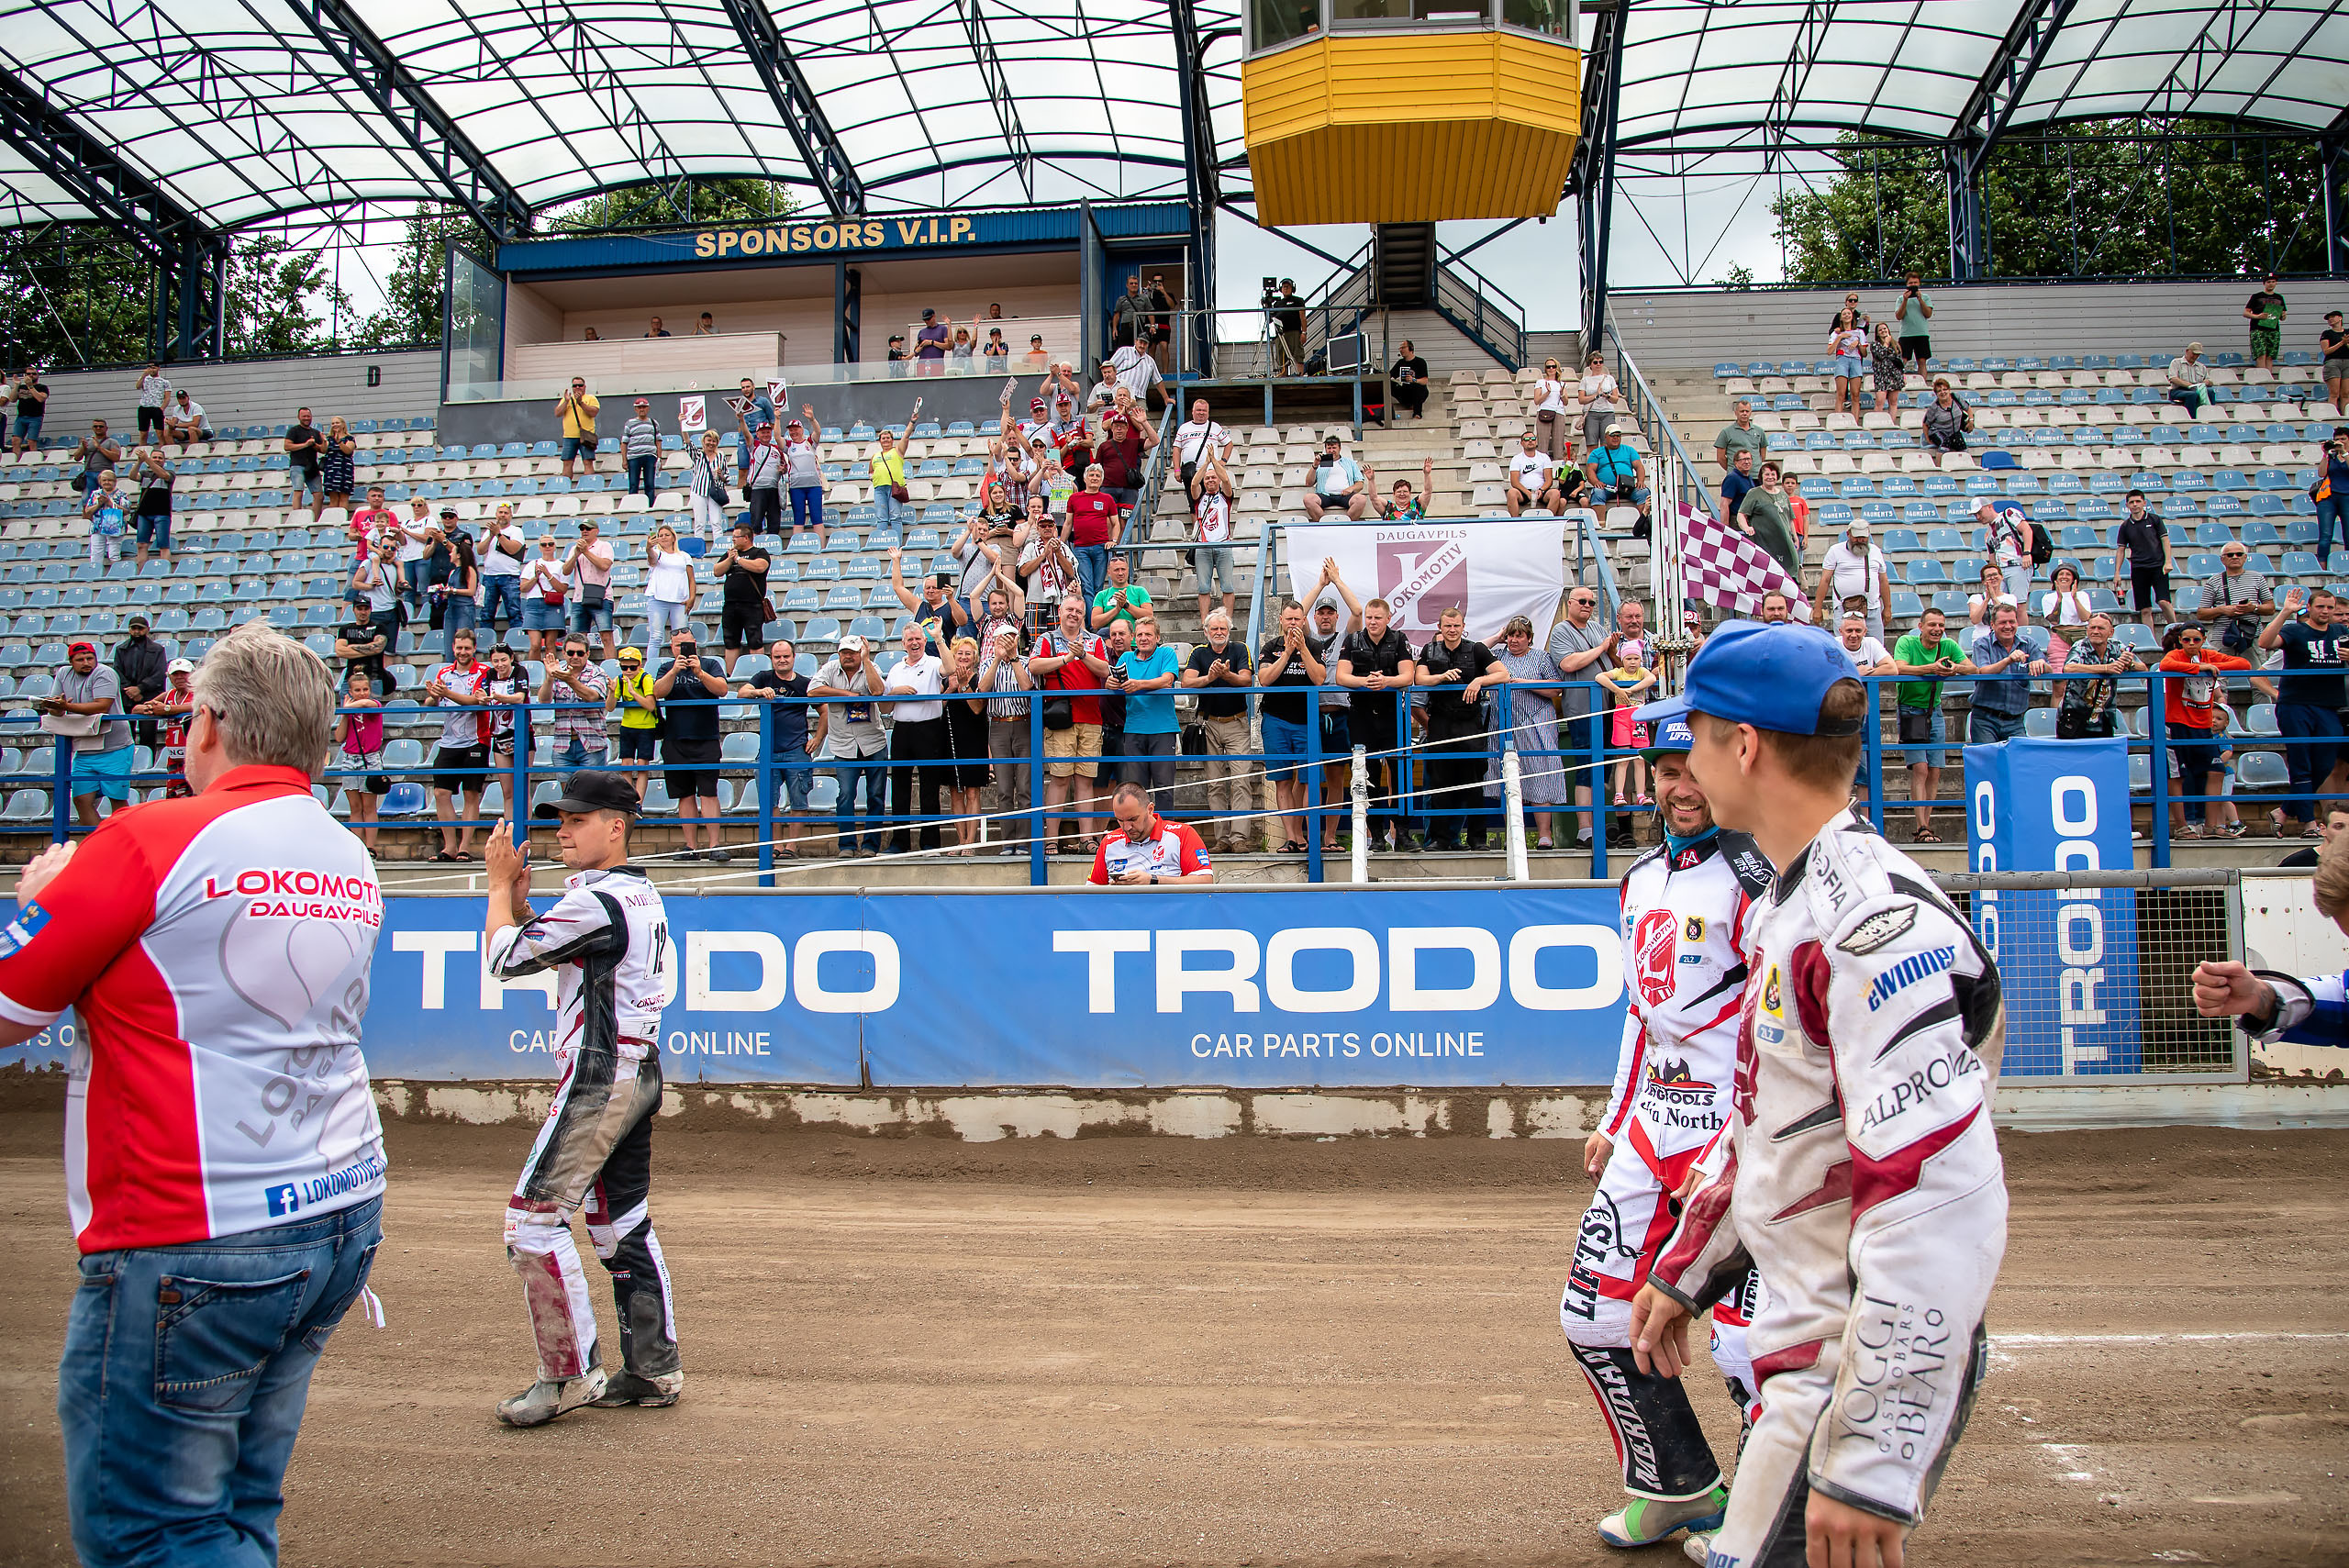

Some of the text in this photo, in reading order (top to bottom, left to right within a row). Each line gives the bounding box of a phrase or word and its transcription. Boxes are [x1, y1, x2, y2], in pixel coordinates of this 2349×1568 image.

[695, 217, 976, 258] SPONSORS V.I.P.
[1376, 530, 1467, 540] DAUGAVPILS
[1390, 544, 1462, 617] LOKOMOTIV
[250, 901, 380, 928] DAUGAVPILS
[653, 921, 667, 974] 12
[393, 930, 901, 1013] TDO
[1052, 924, 1624, 1013] TRODO
[668, 1030, 771, 1055] ONLINE
[1191, 1031, 1485, 1058] CAR PARTS ONLINE
[1664, 1107, 1723, 1130] North
